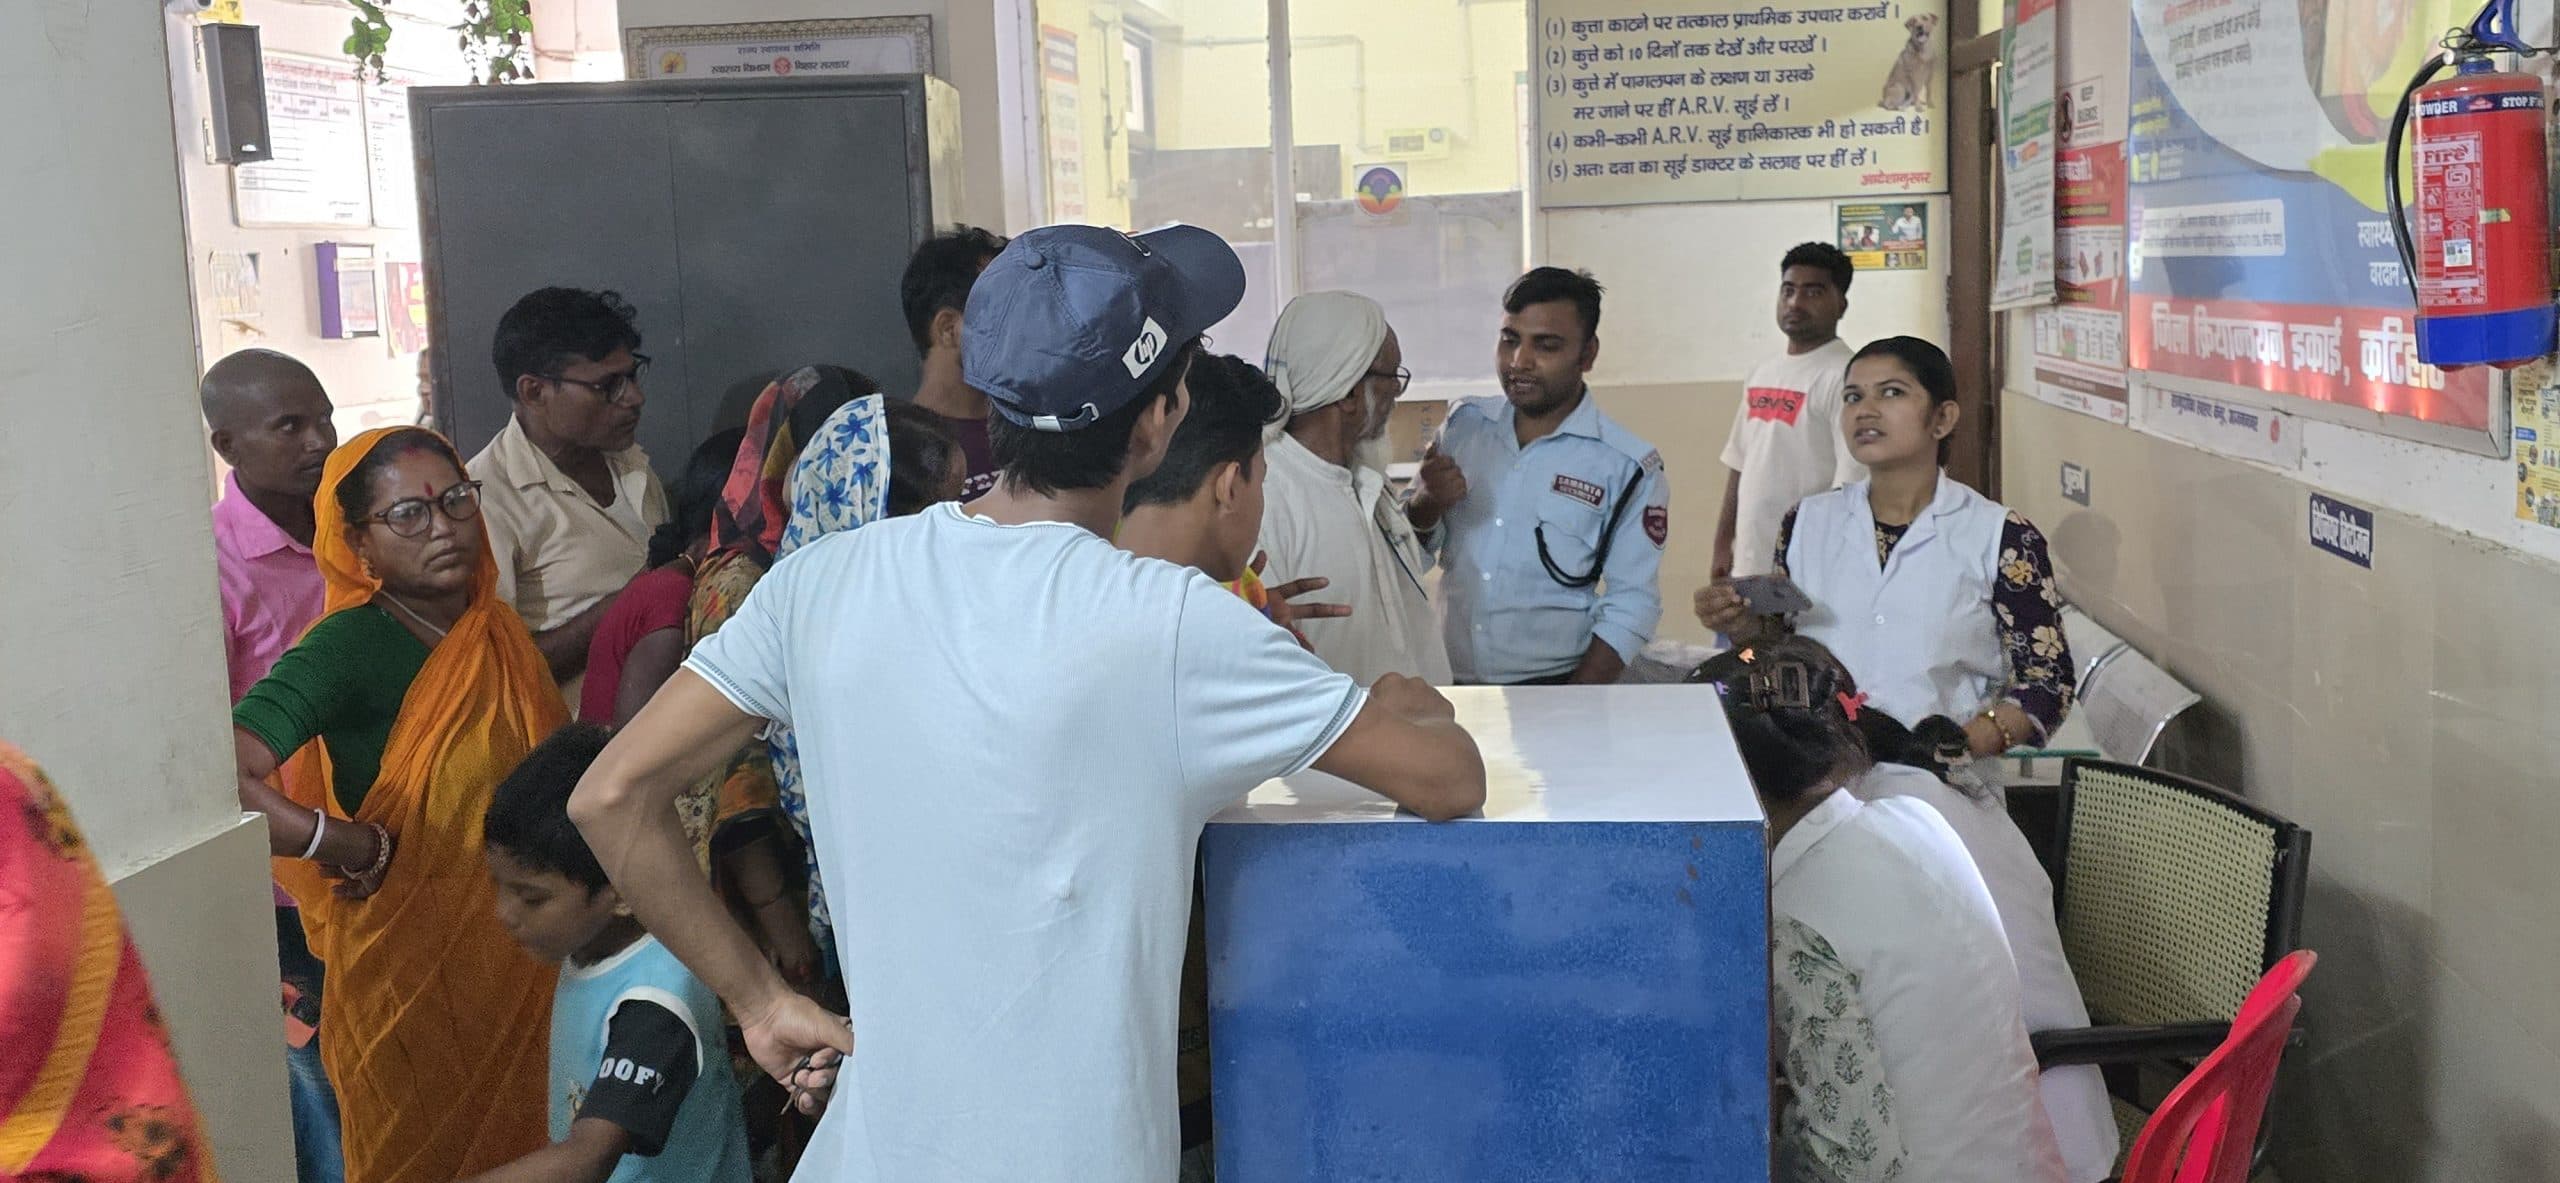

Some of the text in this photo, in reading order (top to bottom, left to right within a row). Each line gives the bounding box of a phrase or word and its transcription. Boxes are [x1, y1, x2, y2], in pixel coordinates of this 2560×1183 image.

[1546, 16, 1566, 40] (1)
[1571, 20, 1603, 42] कुत्ता
[1653, 16, 1672, 30] पर
[1676, 14, 1729, 29] तत्काल
[1733, 7, 1792, 30] प्राथमिक
[1797, 8, 1844, 24] उपचार
[1546, 44, 1566, 70] (2)
[1572, 44, 1599, 70] कुत्ते
[1604, 43, 1624, 60] को
[1629, 48, 1643, 60] 10
[1648, 40, 1682, 59] दिनों
[1684, 44, 1711, 58] तक
[1715, 38, 1745, 57] देखें
[1749, 36, 1775, 56] और
[1779, 34, 1817, 54] परखें
[1546, 64, 1815, 98] (3) कुत्ते में पागलपन के लक्षण या उसके
[1573, 106, 1594, 120] मर
[1599, 100, 1630, 118] जाने
[1635, 104, 1654, 118] पर
[1678, 96, 1729, 115] A.R.V.
[1764, 94, 1780, 113] लें
[1547, 130, 1568, 154] (4)
[1652, 126, 1702, 145] A.R.V.
[1736, 122, 1812, 144] हानिकारक
[1818, 120, 1835, 138] भी
[1840, 119, 1856, 140] हो
[1860, 116, 1906, 137] सकती
[1548, 158, 1568, 183] (5)
[1608, 161, 1635, 176] दवा
[1639, 160, 1659, 174] का
[1691, 158, 1736, 173] डाक्टर
[1739, 152, 1754, 170] के
[1759, 155, 1802, 170] सलाह
[1806, 153, 1826, 168] पर
[1851, 148, 1867, 166] लें
[1135, 332, 1157, 364] hp
